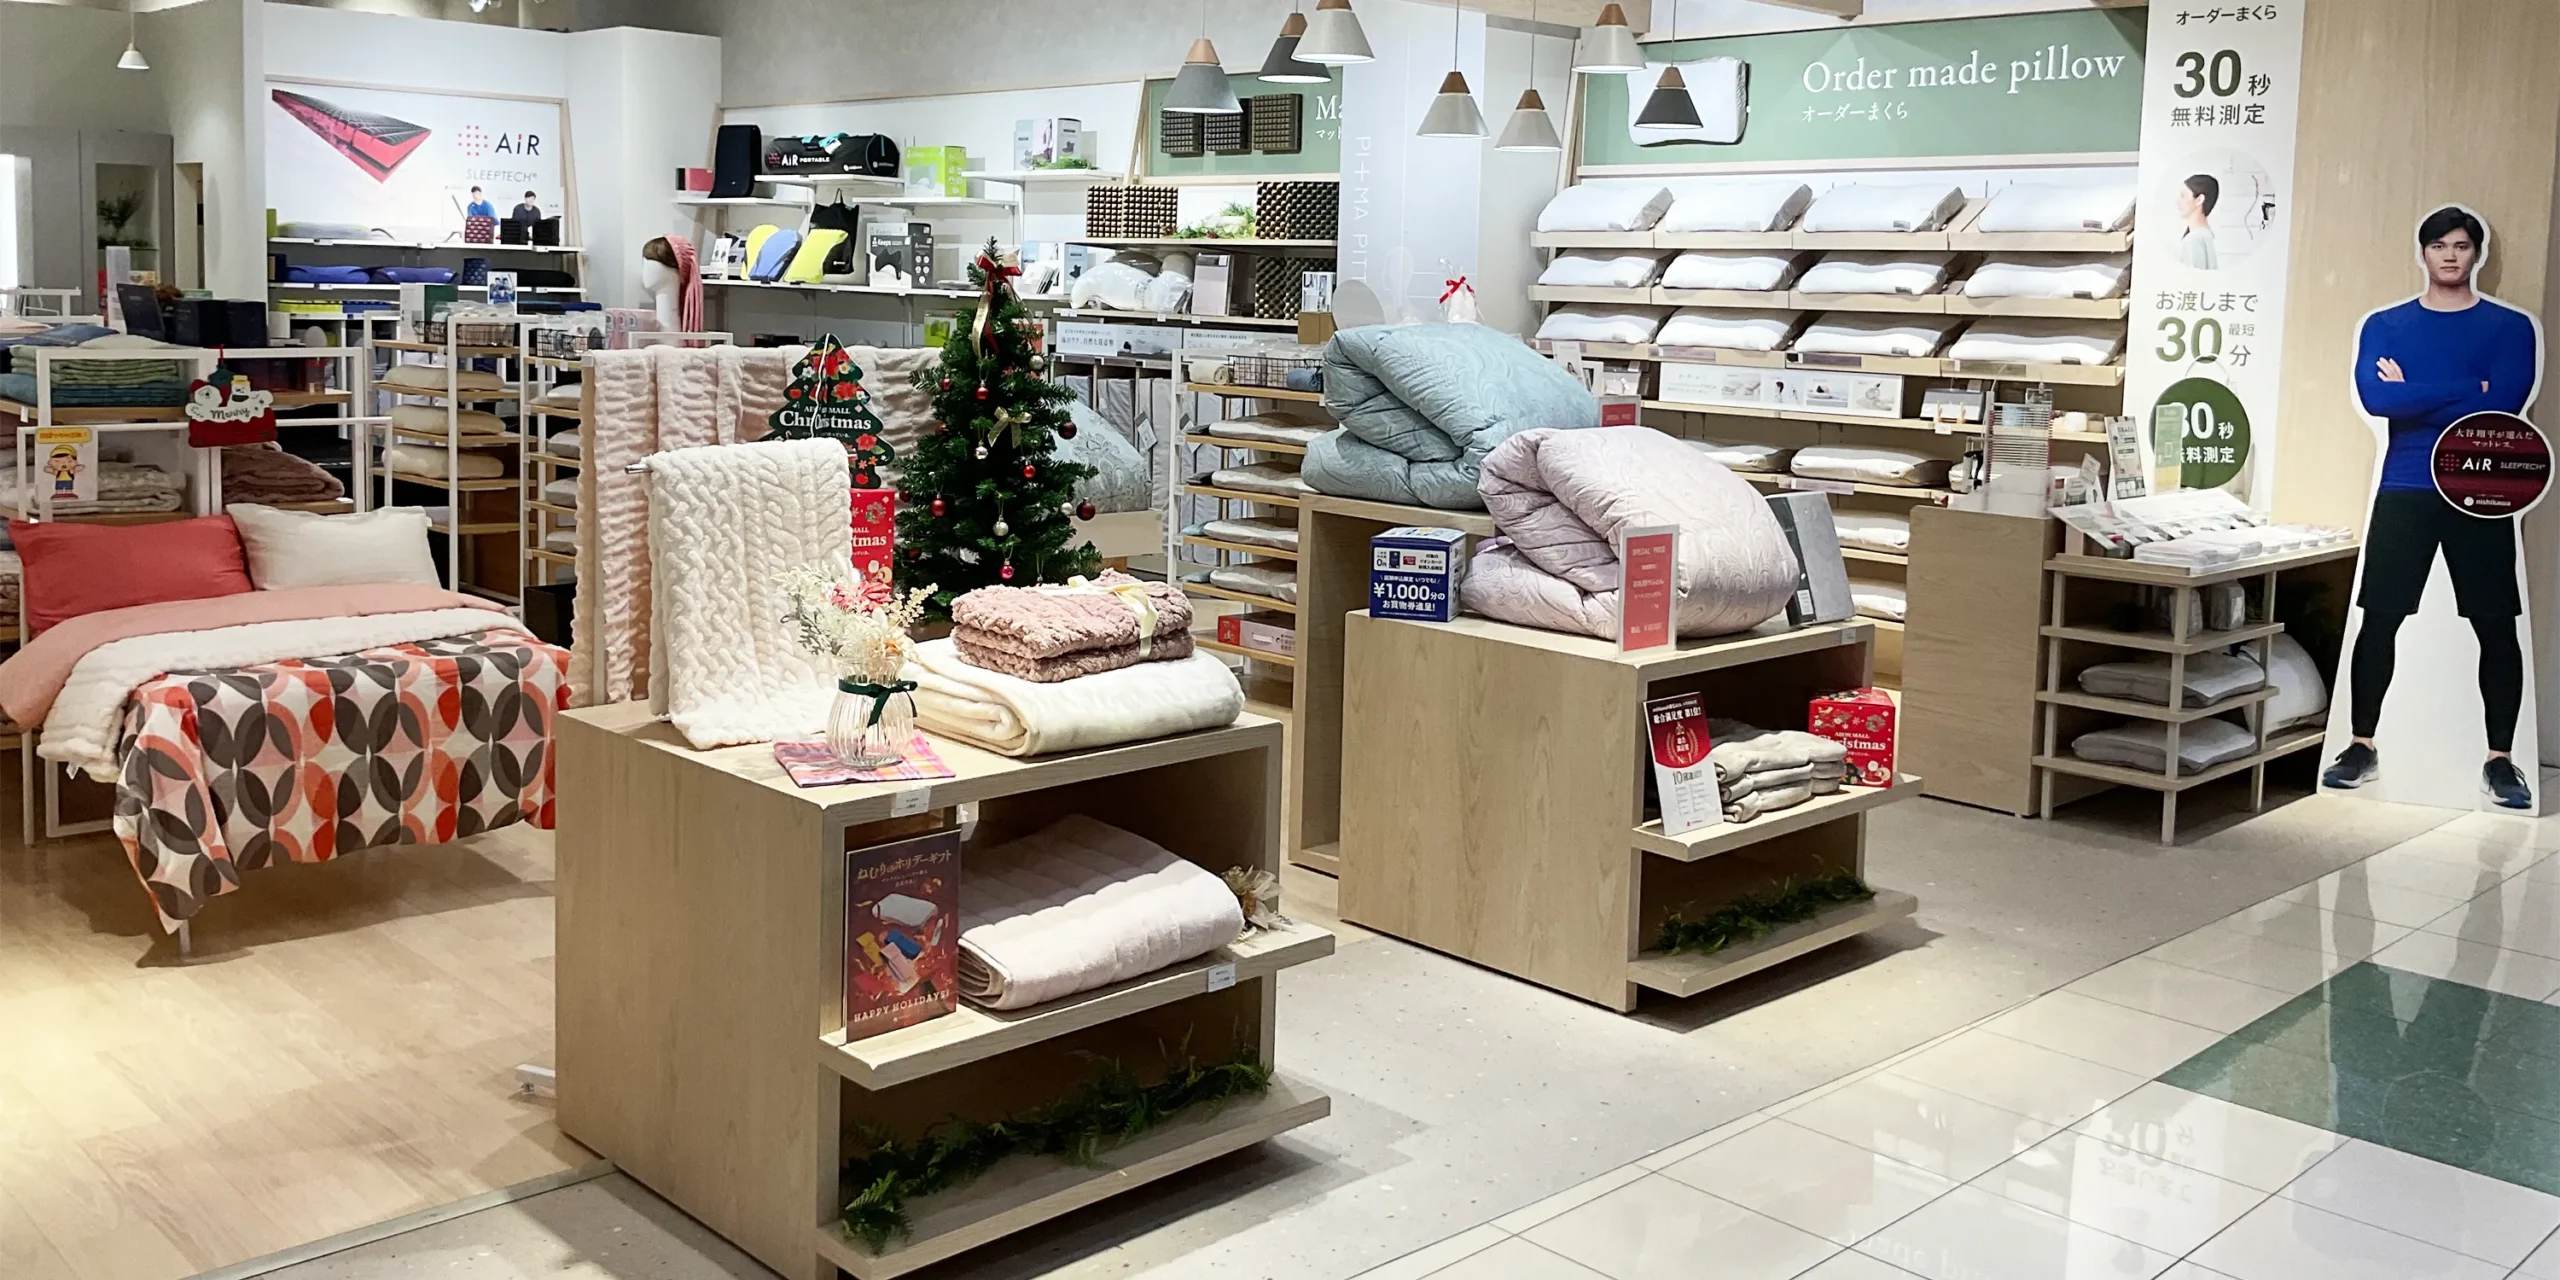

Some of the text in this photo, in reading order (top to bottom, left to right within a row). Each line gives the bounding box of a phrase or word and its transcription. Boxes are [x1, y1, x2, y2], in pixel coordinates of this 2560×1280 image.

[2176, 5, 2277, 25] オーダーまくら
[1803, 44, 2125, 94] Order made pillow
[1802, 101, 1908, 122] オーダーまくら
[2171, 103, 2265, 127] 無料測定
[2156, 291, 2259, 313] お渡しまで
[2228, 323, 2256, 336] 最短
[2455, 428, 2535, 440] 大谷翔平が選んだ
[2181, 446, 2235, 464] 料測定
[2476, 499, 2511, 507] nishikawa
[857, 850, 952, 880] ねむりのホリデーギフト
[854, 990, 949, 1023] HAPPY HOLIDAYS!
